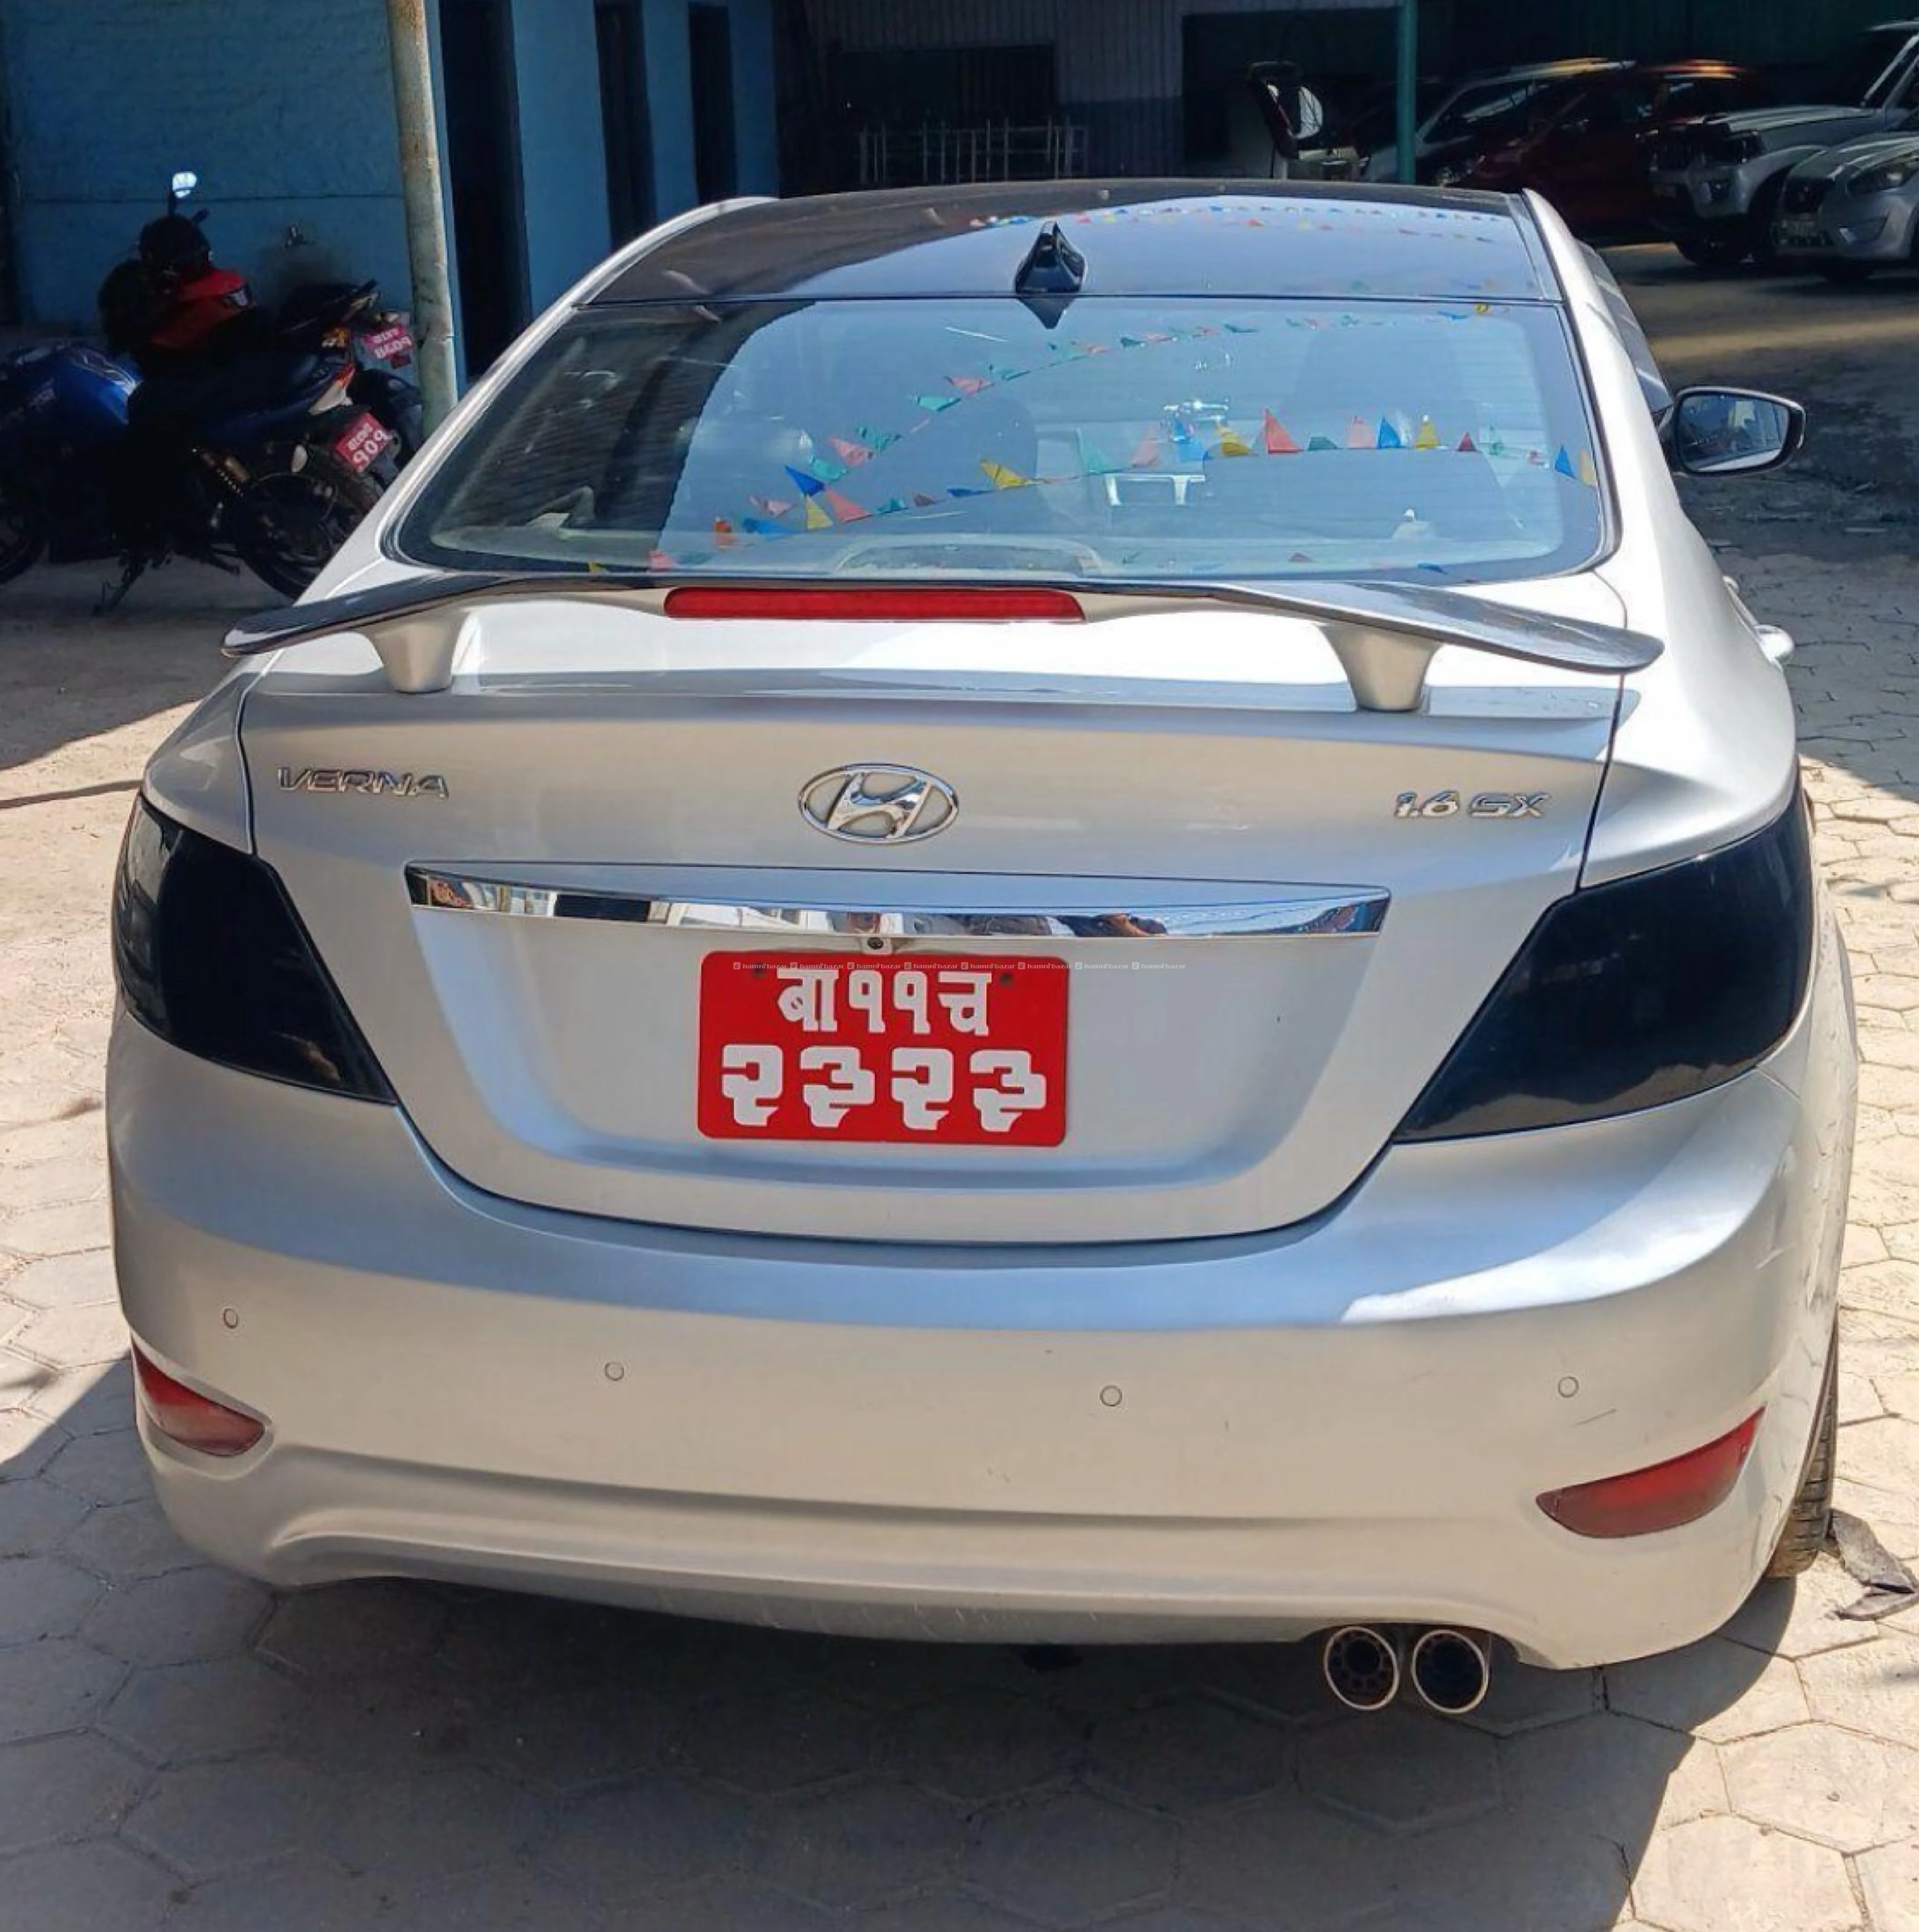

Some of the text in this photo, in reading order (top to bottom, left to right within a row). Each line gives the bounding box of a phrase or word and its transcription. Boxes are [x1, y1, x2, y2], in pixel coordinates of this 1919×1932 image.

[277, 766, 449, 798] VERNA
[1394, 790, 1551, 819] 1.6 SX
[721, 1044, 1047, 1132] २३२३
